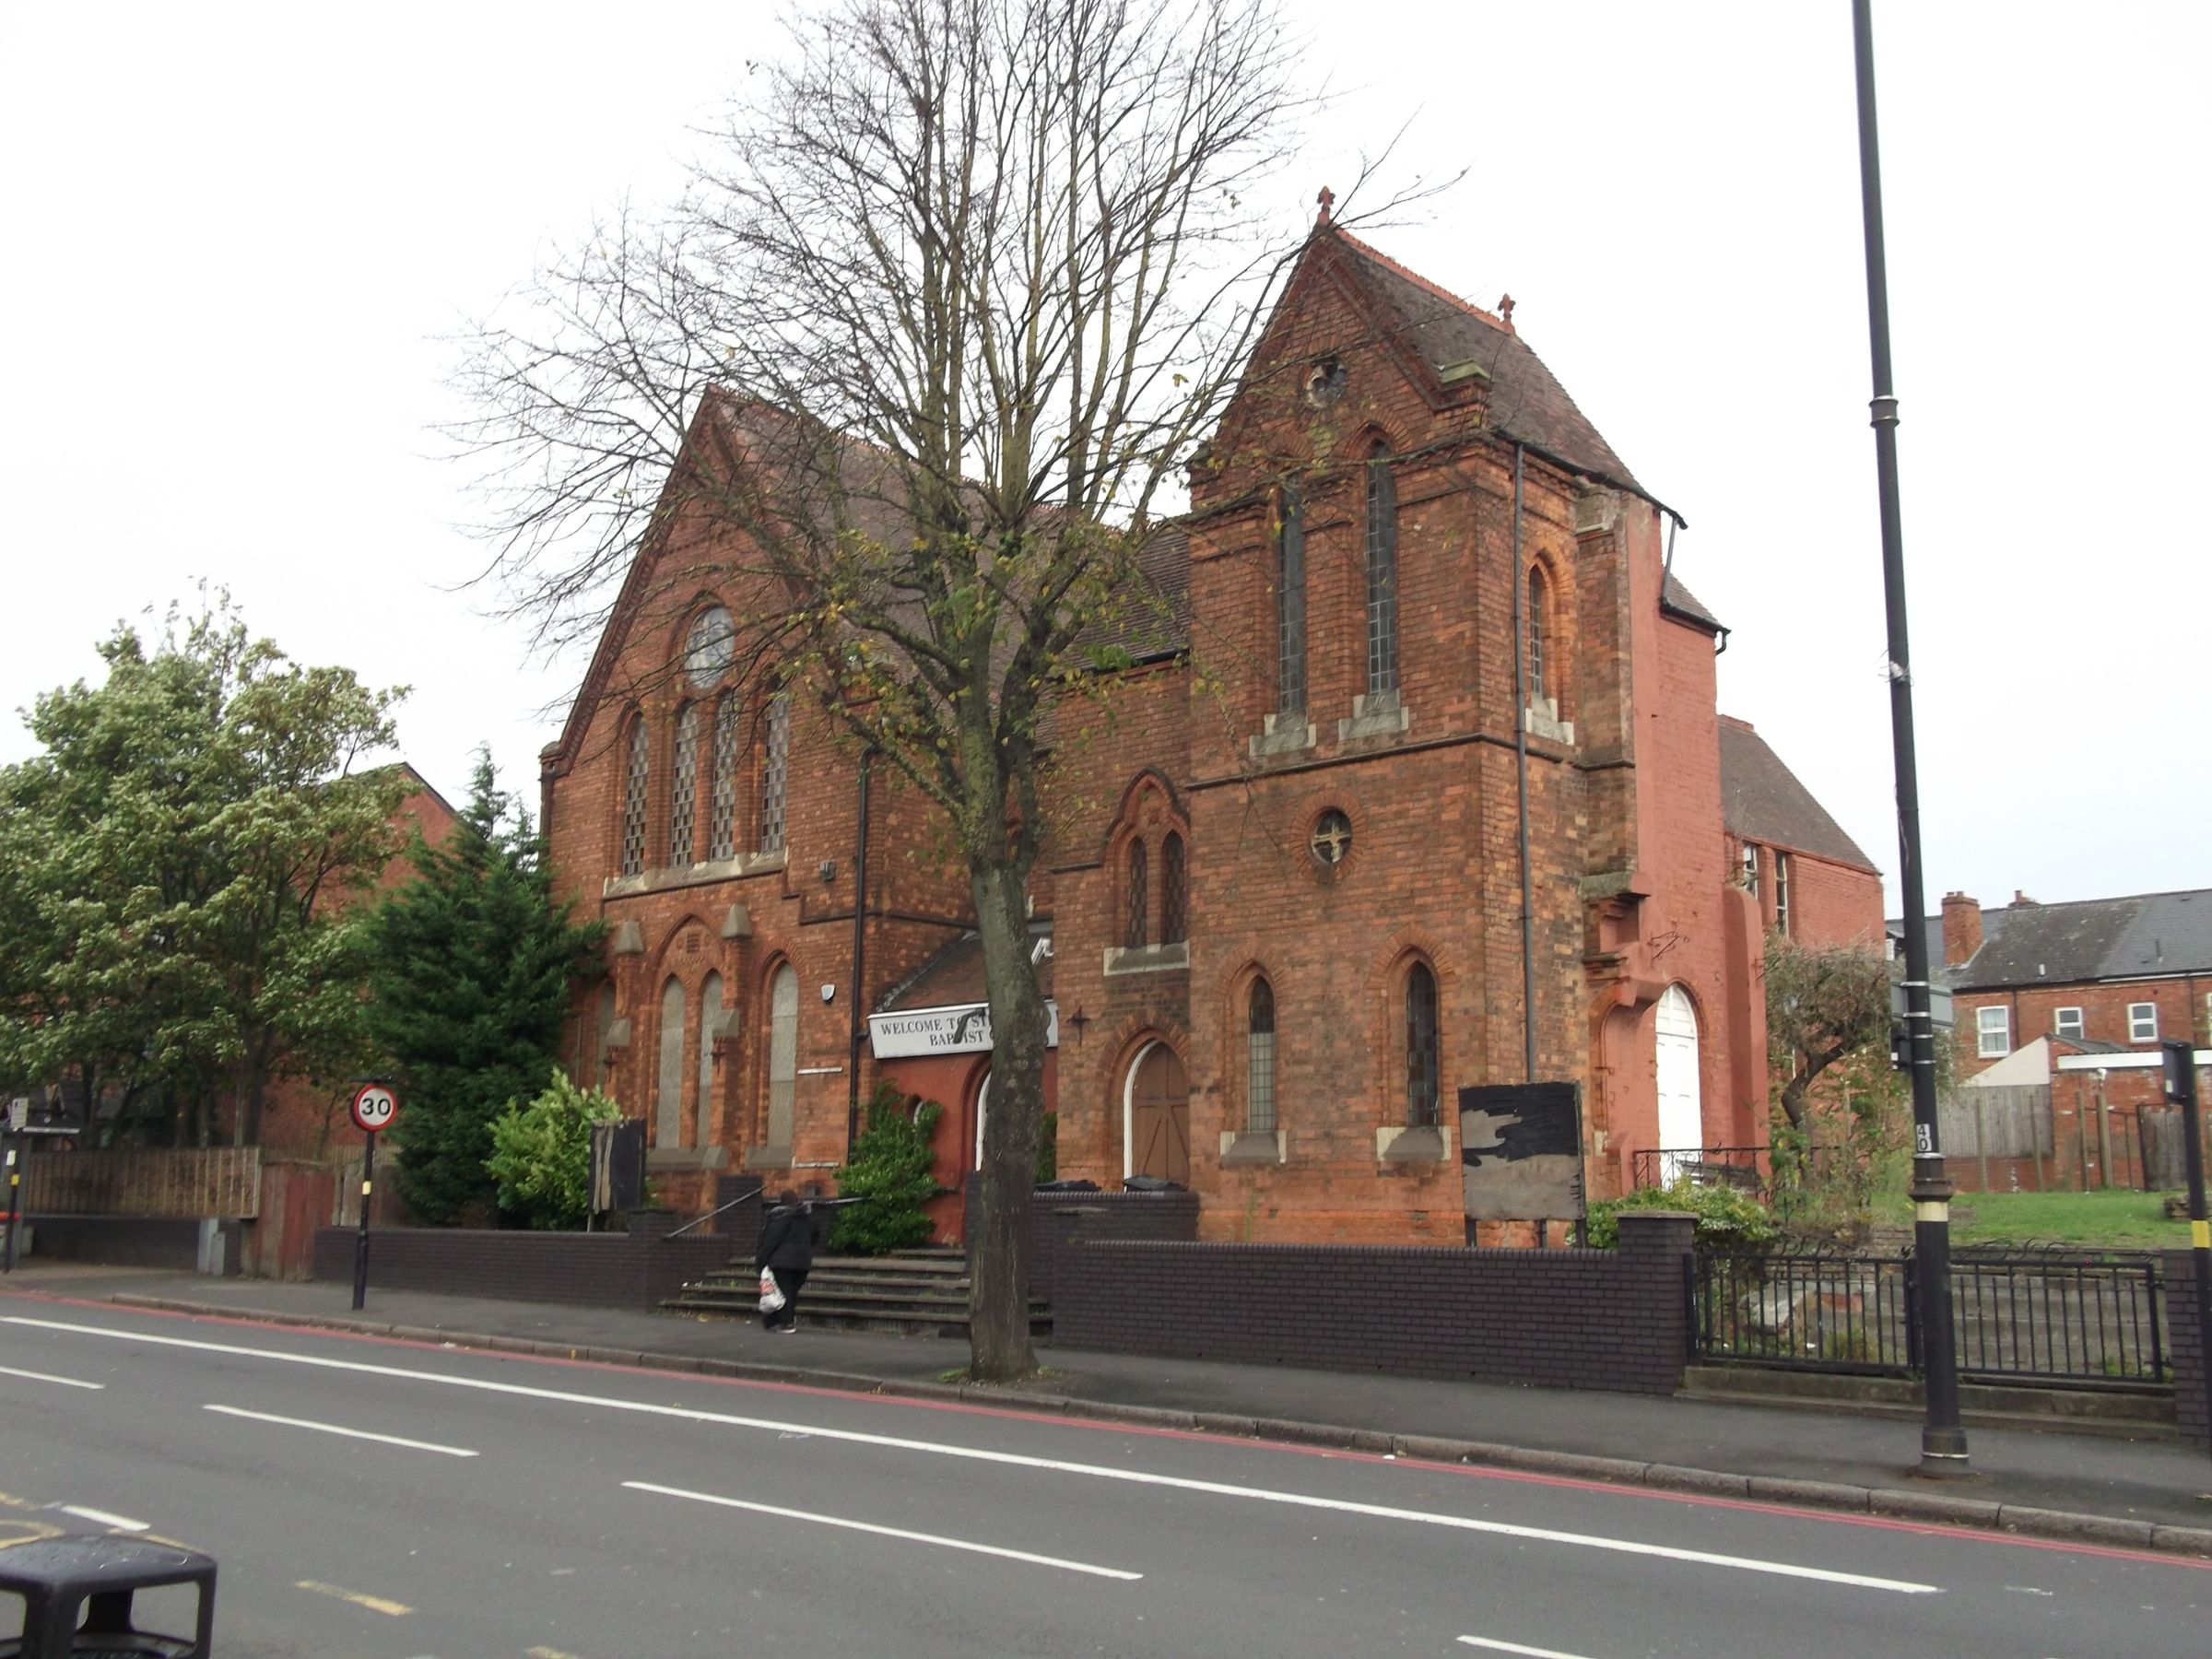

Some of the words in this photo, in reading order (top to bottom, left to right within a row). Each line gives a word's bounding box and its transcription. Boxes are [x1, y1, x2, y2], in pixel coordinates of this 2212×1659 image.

[880, 1018, 942, 1035] WELCOME
[930, 1030, 983, 1046] BAPIST
[361, 1098, 391, 1116] 30
[1918, 1125, 1928, 1151] 40
